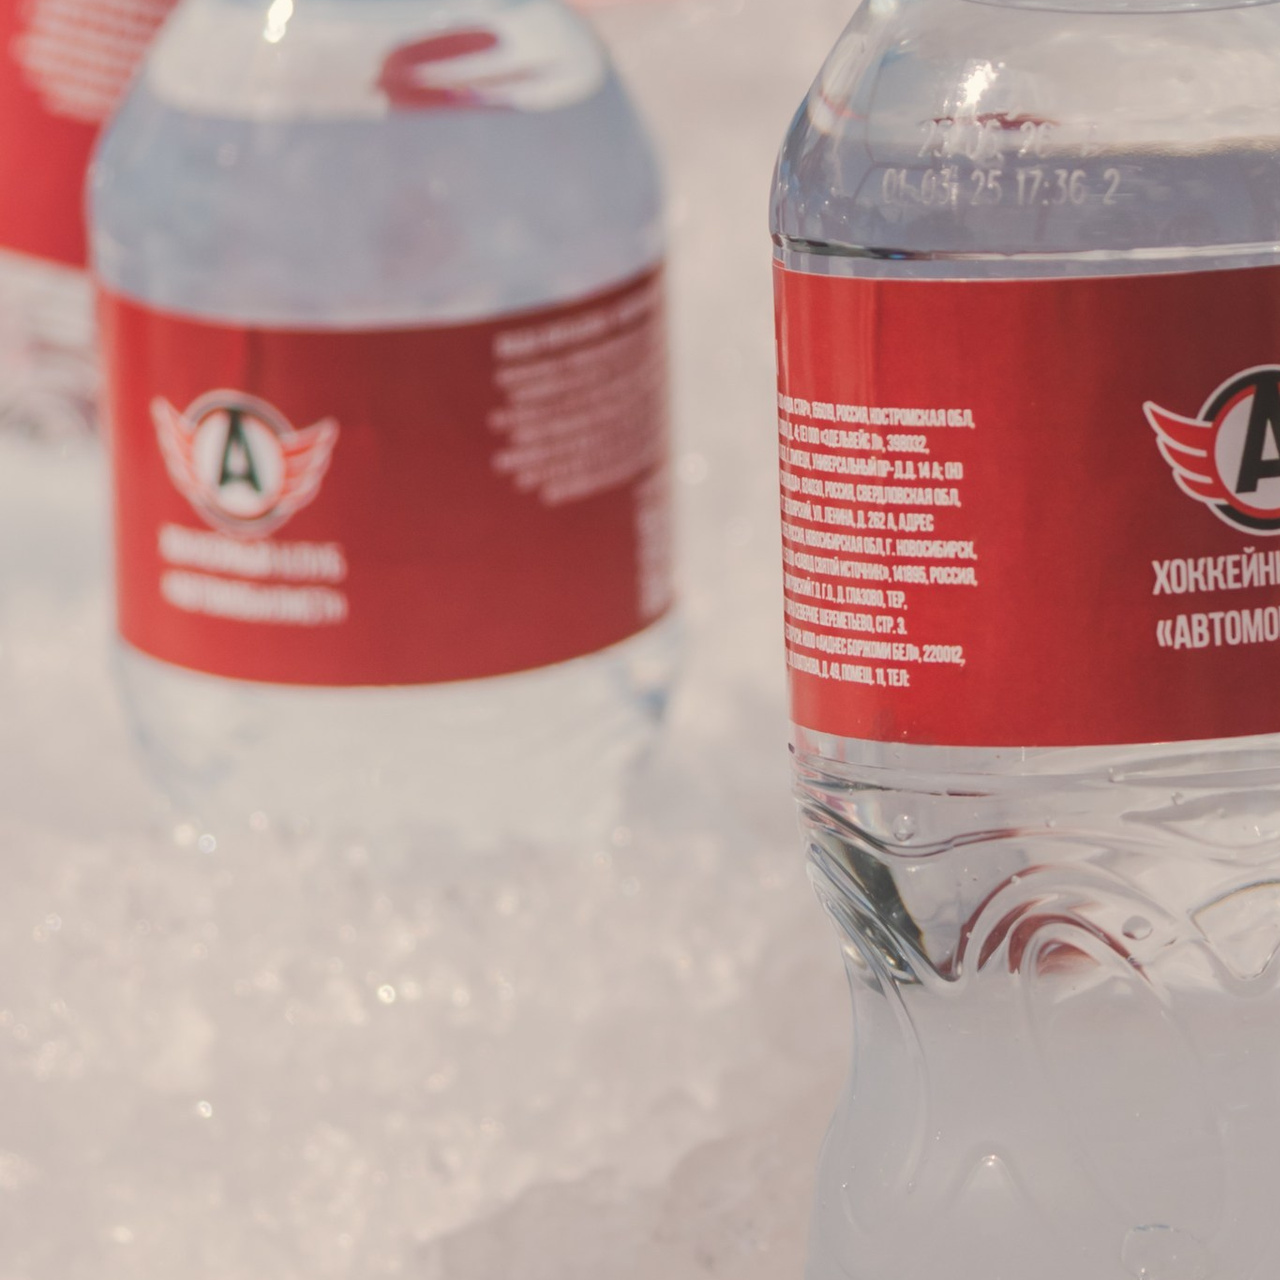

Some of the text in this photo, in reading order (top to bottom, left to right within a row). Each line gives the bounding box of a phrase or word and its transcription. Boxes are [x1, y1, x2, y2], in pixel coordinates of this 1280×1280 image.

[898, 513, 934, 532] АДРЕС
[895, 539, 977, 558] НОВОСИБИРСК,
[929, 567, 977, 585] РОССИЯ,
